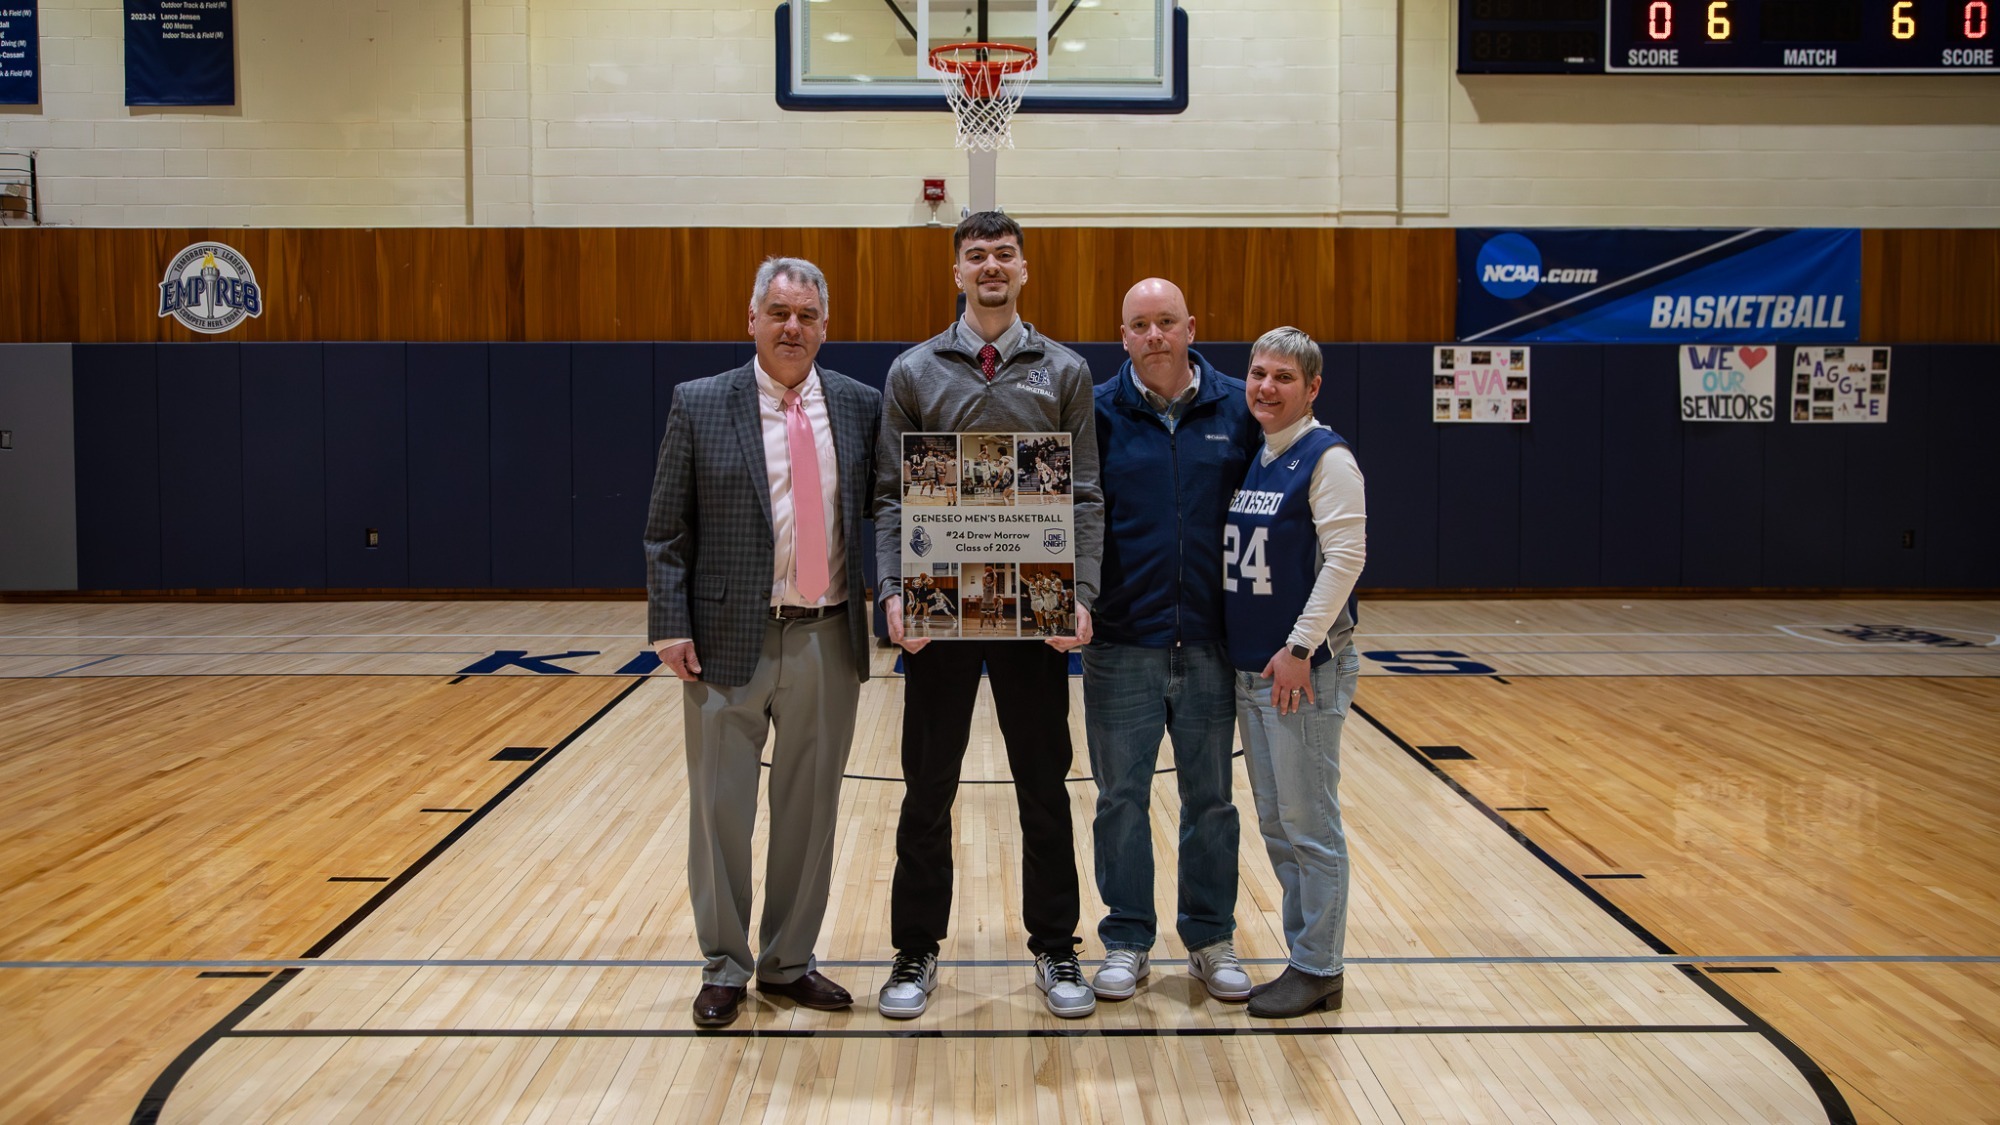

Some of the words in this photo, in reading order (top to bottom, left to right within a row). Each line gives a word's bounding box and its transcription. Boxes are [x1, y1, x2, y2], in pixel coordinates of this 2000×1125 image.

[161, 1, 182, 9] Outdoor
[131, 13, 156, 21] 2023-24
[160, 13, 179, 21] Lance
[179, 13, 201, 21] Jensen
[1649, 1, 1672, 40] 0
[1707, 1, 1731, 40] 6
[1892, 1, 1915, 39] 6
[1964, 1, 1987, 39] 0
[1628, 49, 1679, 66] SCORE
[1783, 49, 1837, 66] MATCH
[1942, 49, 1994, 65] SCORE
[221, 250, 247, 276] LEADERS
[1483, 265, 1598, 284] NCAA.com
[1650, 295, 1846, 329] BASKETBALL
[207, 320, 223, 328] HERE
[1688, 346, 1734, 370] WE
[1016, 382, 1056, 400] BASKETBALL
[1454, 369, 1506, 396] EVA
[1702, 371, 1745, 392] OUR
[1683, 394, 1773, 420] SENIORS
[912, 514, 962, 523] GENESEO
[965, 514, 996, 523] MEN'S
[998, 514, 1063, 523] BASKETBALL
[946, 531, 965, 540] #24
[967, 531, 992, 539] Drew
[994, 531, 1030, 540] Morrow
[955, 543, 981, 552] Class
[983, 543, 994, 552] of
[995, 543, 1021, 552] 2026
[1222, 523, 1272, 595] 24
